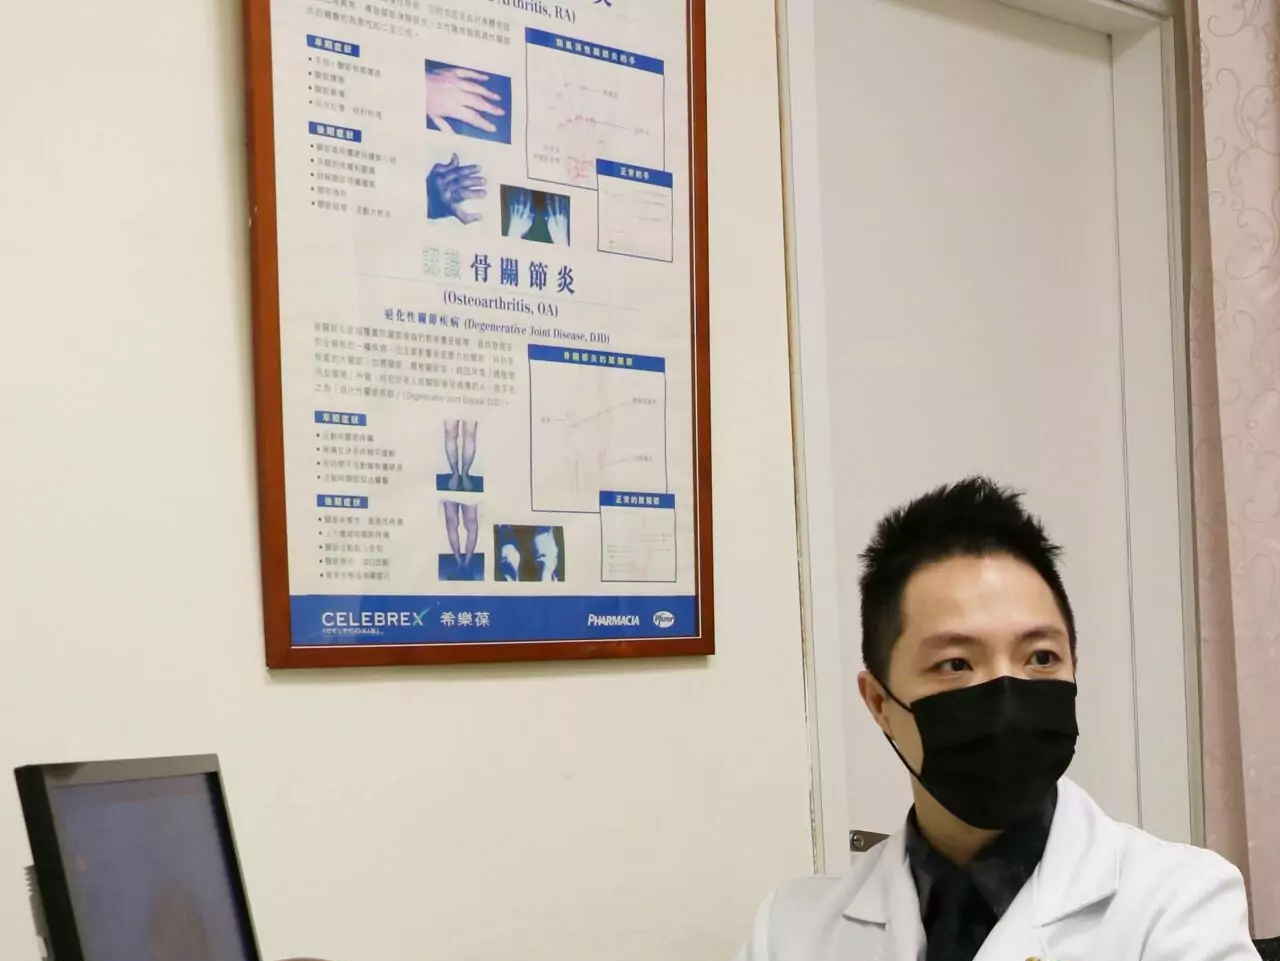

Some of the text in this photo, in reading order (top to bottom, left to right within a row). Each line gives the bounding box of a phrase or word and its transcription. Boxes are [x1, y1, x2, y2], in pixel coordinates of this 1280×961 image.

[554, 5, 576, 24] RA)
[620, 166, 650, 181] 正常的手
[470, 253, 576, 295] 骨關節炎
[443, 290, 559, 318] (Osteoarthritis, OA)
[384, 307, 610, 344] 退化性關節疾病 (Degenerative Joint Disease, DJD)
[322, 607, 674, 628] CELEBREX 希樂葆 PHARMACIA Pfizer
